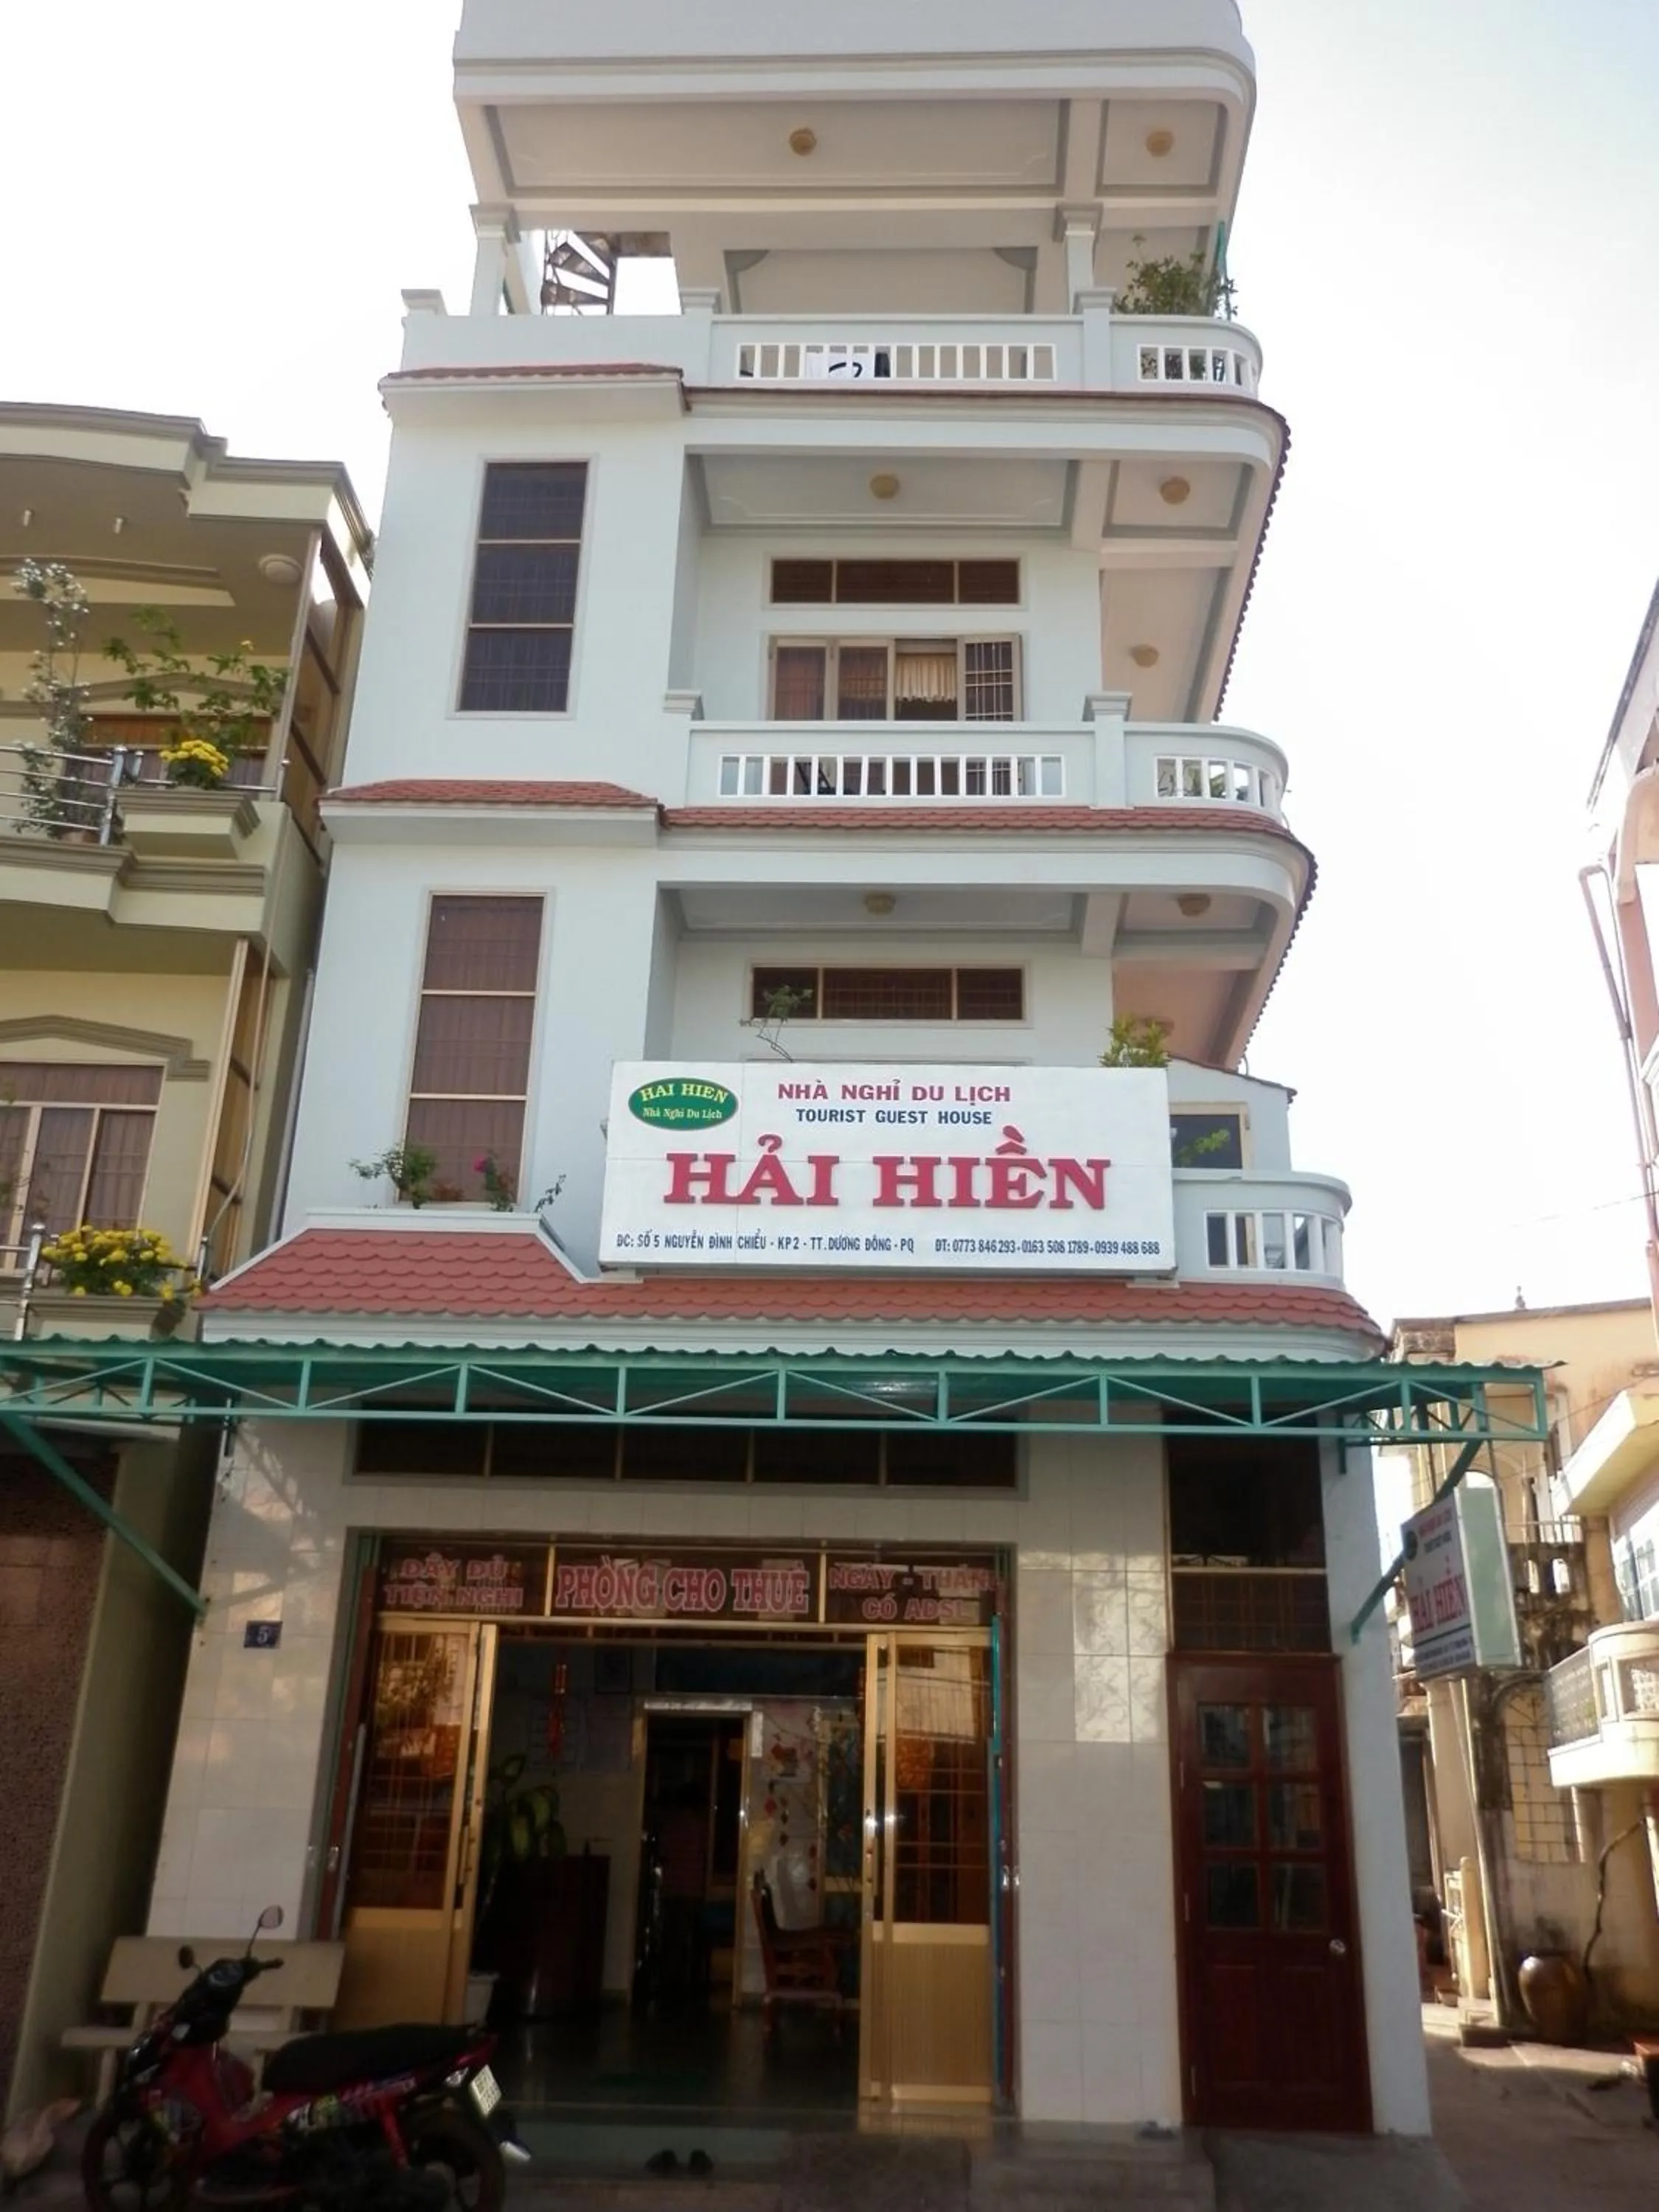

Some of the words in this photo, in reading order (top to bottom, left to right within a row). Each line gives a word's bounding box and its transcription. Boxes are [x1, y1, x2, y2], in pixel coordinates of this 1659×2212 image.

[778, 1079, 829, 1100] NHÀ
[841, 1079, 900, 1101] NGHỈ
[911, 1085, 945, 1102] DU
[955, 1086, 1010, 1106] LỊCH
[686, 1109, 700, 1119] Du
[796, 1108, 866, 1123] TOURIST
[875, 1110, 928, 1124] GUEST
[938, 1110, 992, 1124] HOUSE
[663, 1133, 840, 1206] HẢI
[872, 1124, 1110, 1210] HIỀN
[637, 1229, 653, 1248] SỐ
[654, 1234, 660, 1248] 5
[709, 1233, 732, 1249] ĐÌNH
[900, 1238, 914, 1253] PQ
[952, 1239, 975, 1253] 0773
[556, 1555, 658, 1609] PHÒNG
[664, 1568, 726, 1612] CHO
[862, 1593, 897, 1618] CÓ
